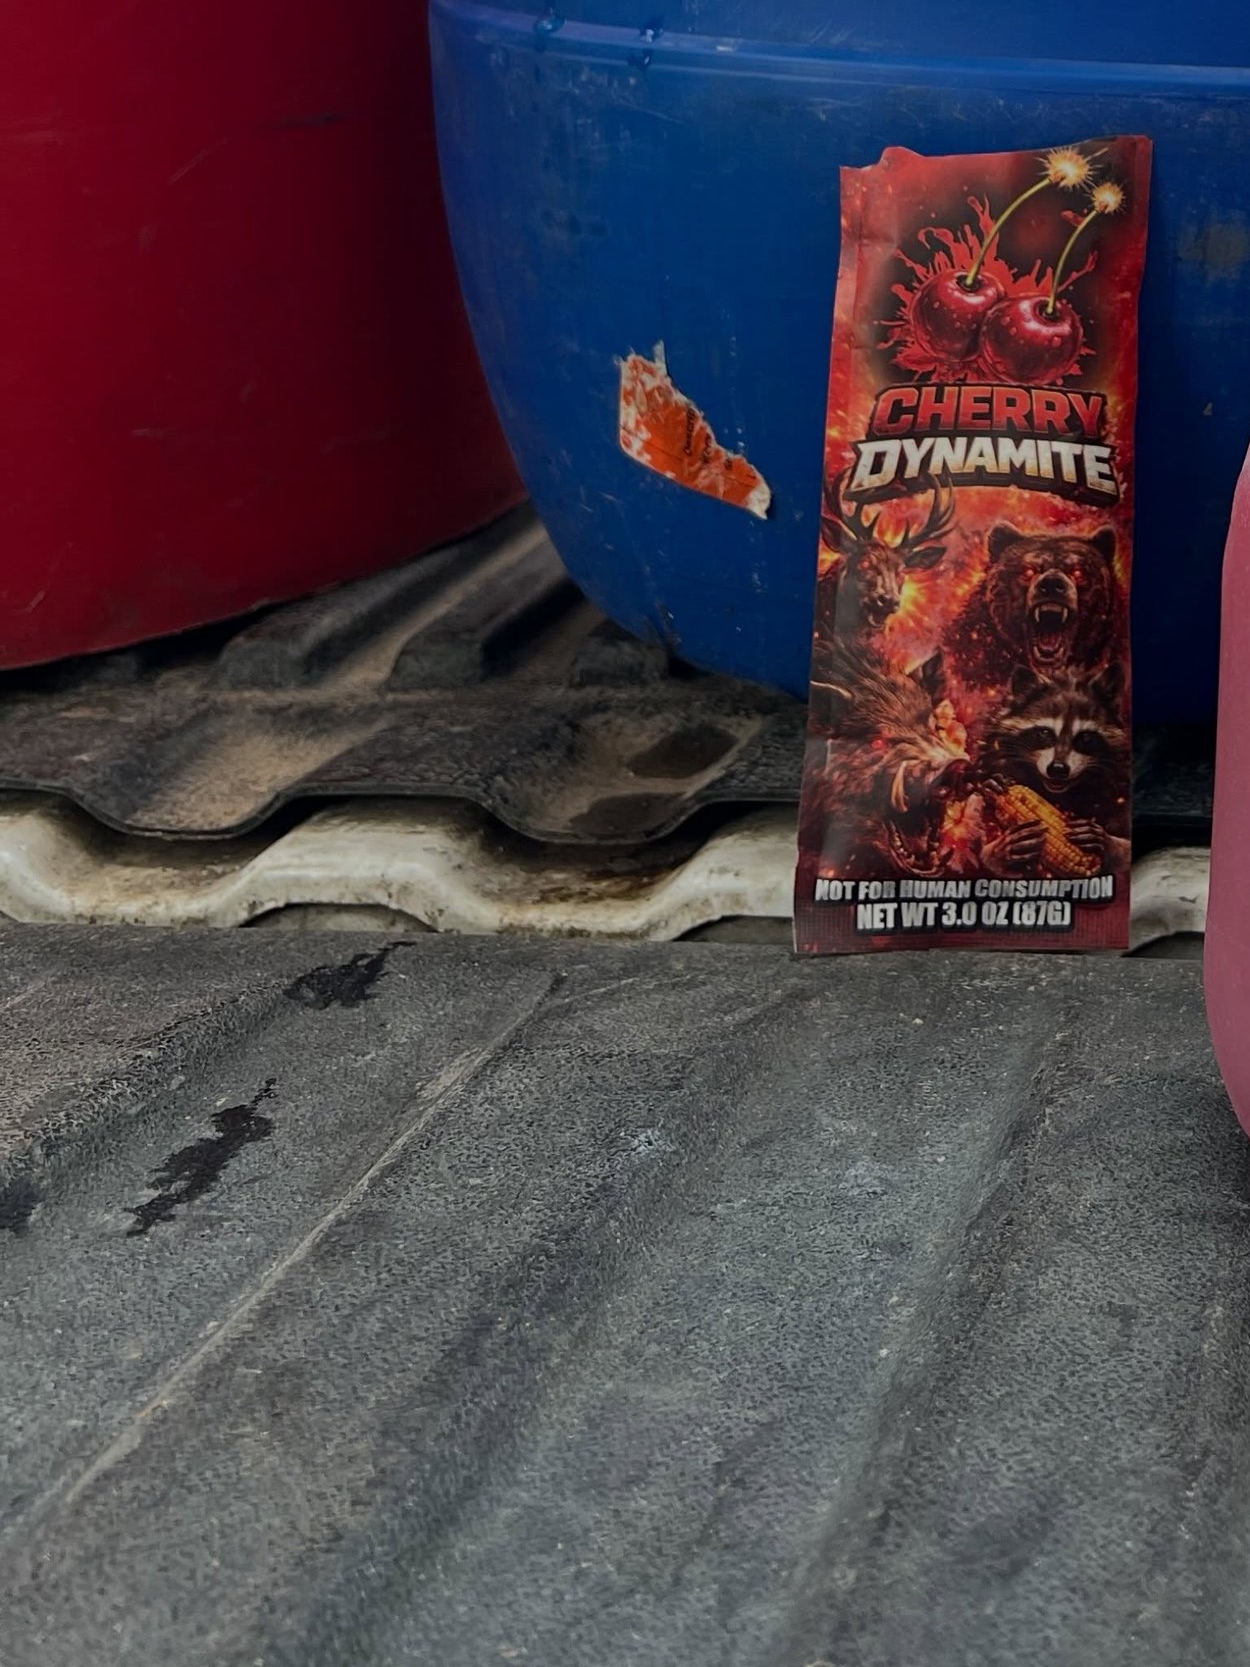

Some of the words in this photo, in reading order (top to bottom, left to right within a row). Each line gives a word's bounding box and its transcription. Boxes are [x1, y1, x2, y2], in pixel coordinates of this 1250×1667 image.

[873, 385, 1103, 436] CHERRY
[850, 436, 1118, 496] DYNAMITE
[815, 879, 856, 901] NOT
[858, 881, 896, 900] FOR
[900, 879, 971, 899] HUMAN
[974, 875, 1114, 898] CONSUMPTION
[857, 903, 898, 929] NET
[900, 902, 939, 927] WT
[942, 902, 976, 926] 3.0
[981, 901, 1009, 925] OZ
[1013, 900, 1071, 926] (87G)
